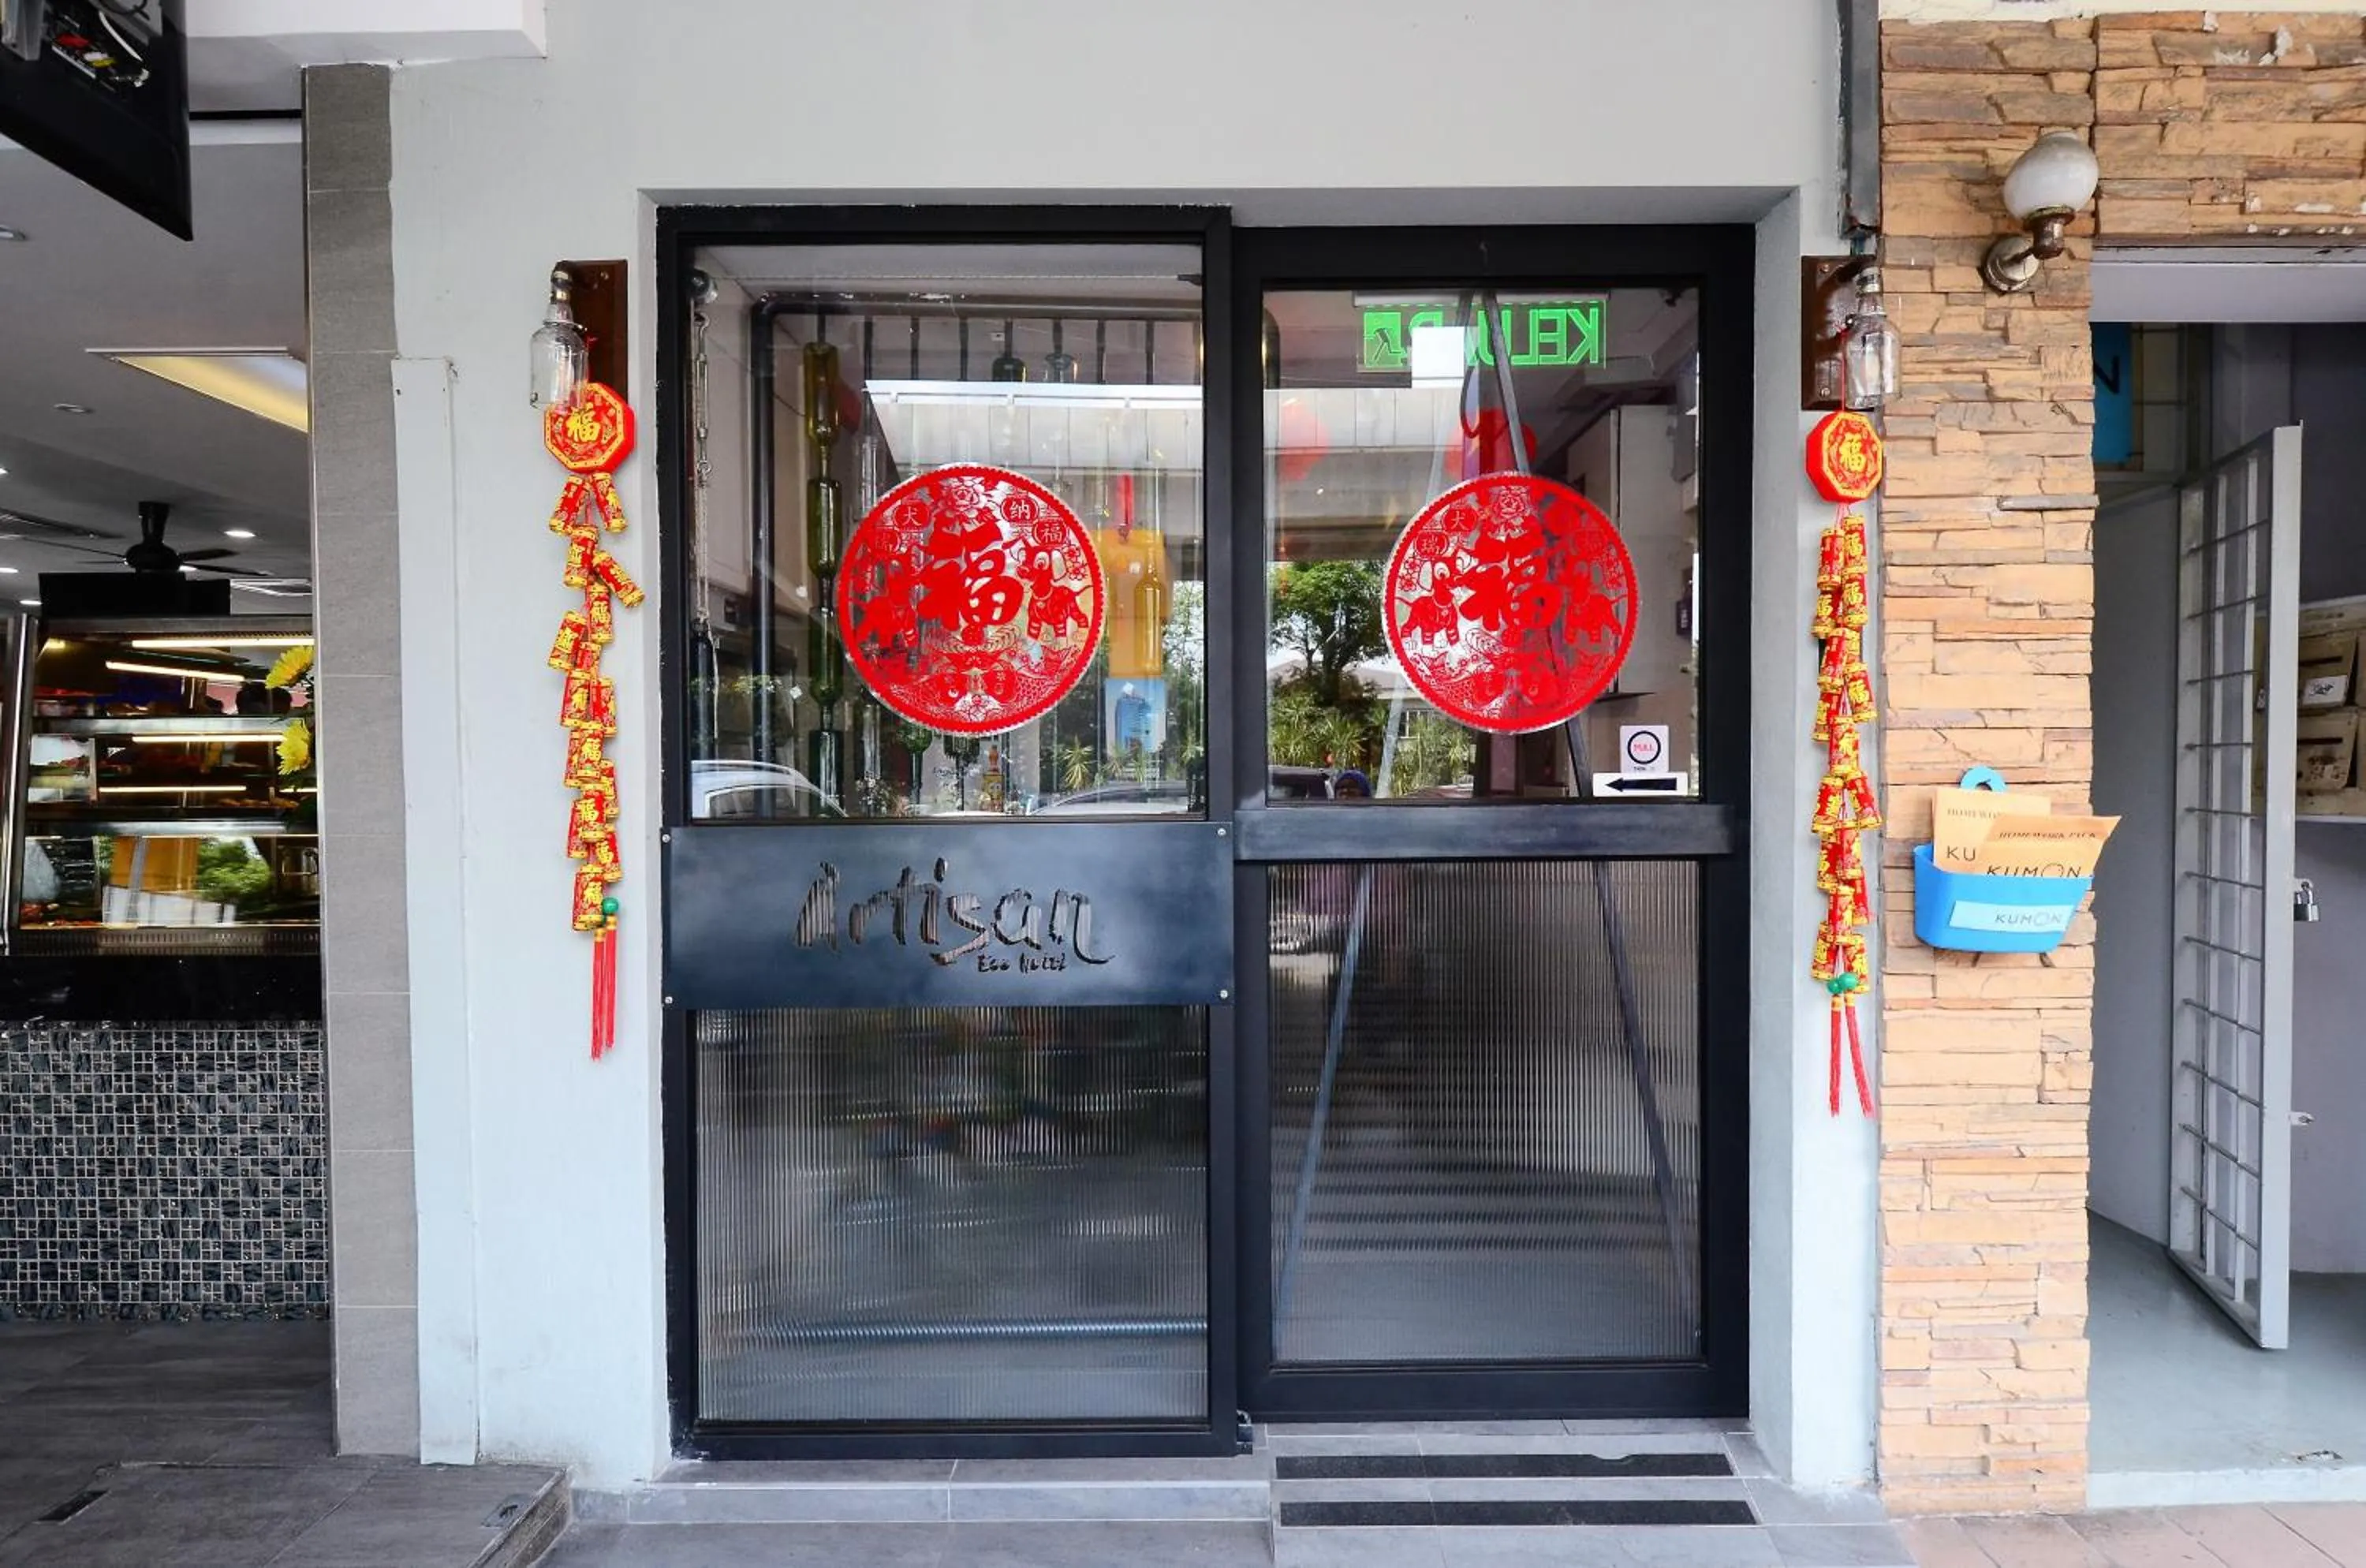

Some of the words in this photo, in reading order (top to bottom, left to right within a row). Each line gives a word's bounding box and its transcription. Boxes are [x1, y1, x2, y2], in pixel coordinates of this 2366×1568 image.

[566, 404, 600, 442] 福
[1839, 433, 1866, 472] 福
[1009, 498, 1031, 519] 纳
[1040, 522, 1063, 543] 福
[916, 510, 1024, 632] 福
[1459, 518, 1564, 633] 福
[796, 857, 1116, 966] Artisan
[1995, 911, 2063, 927] KUMON
